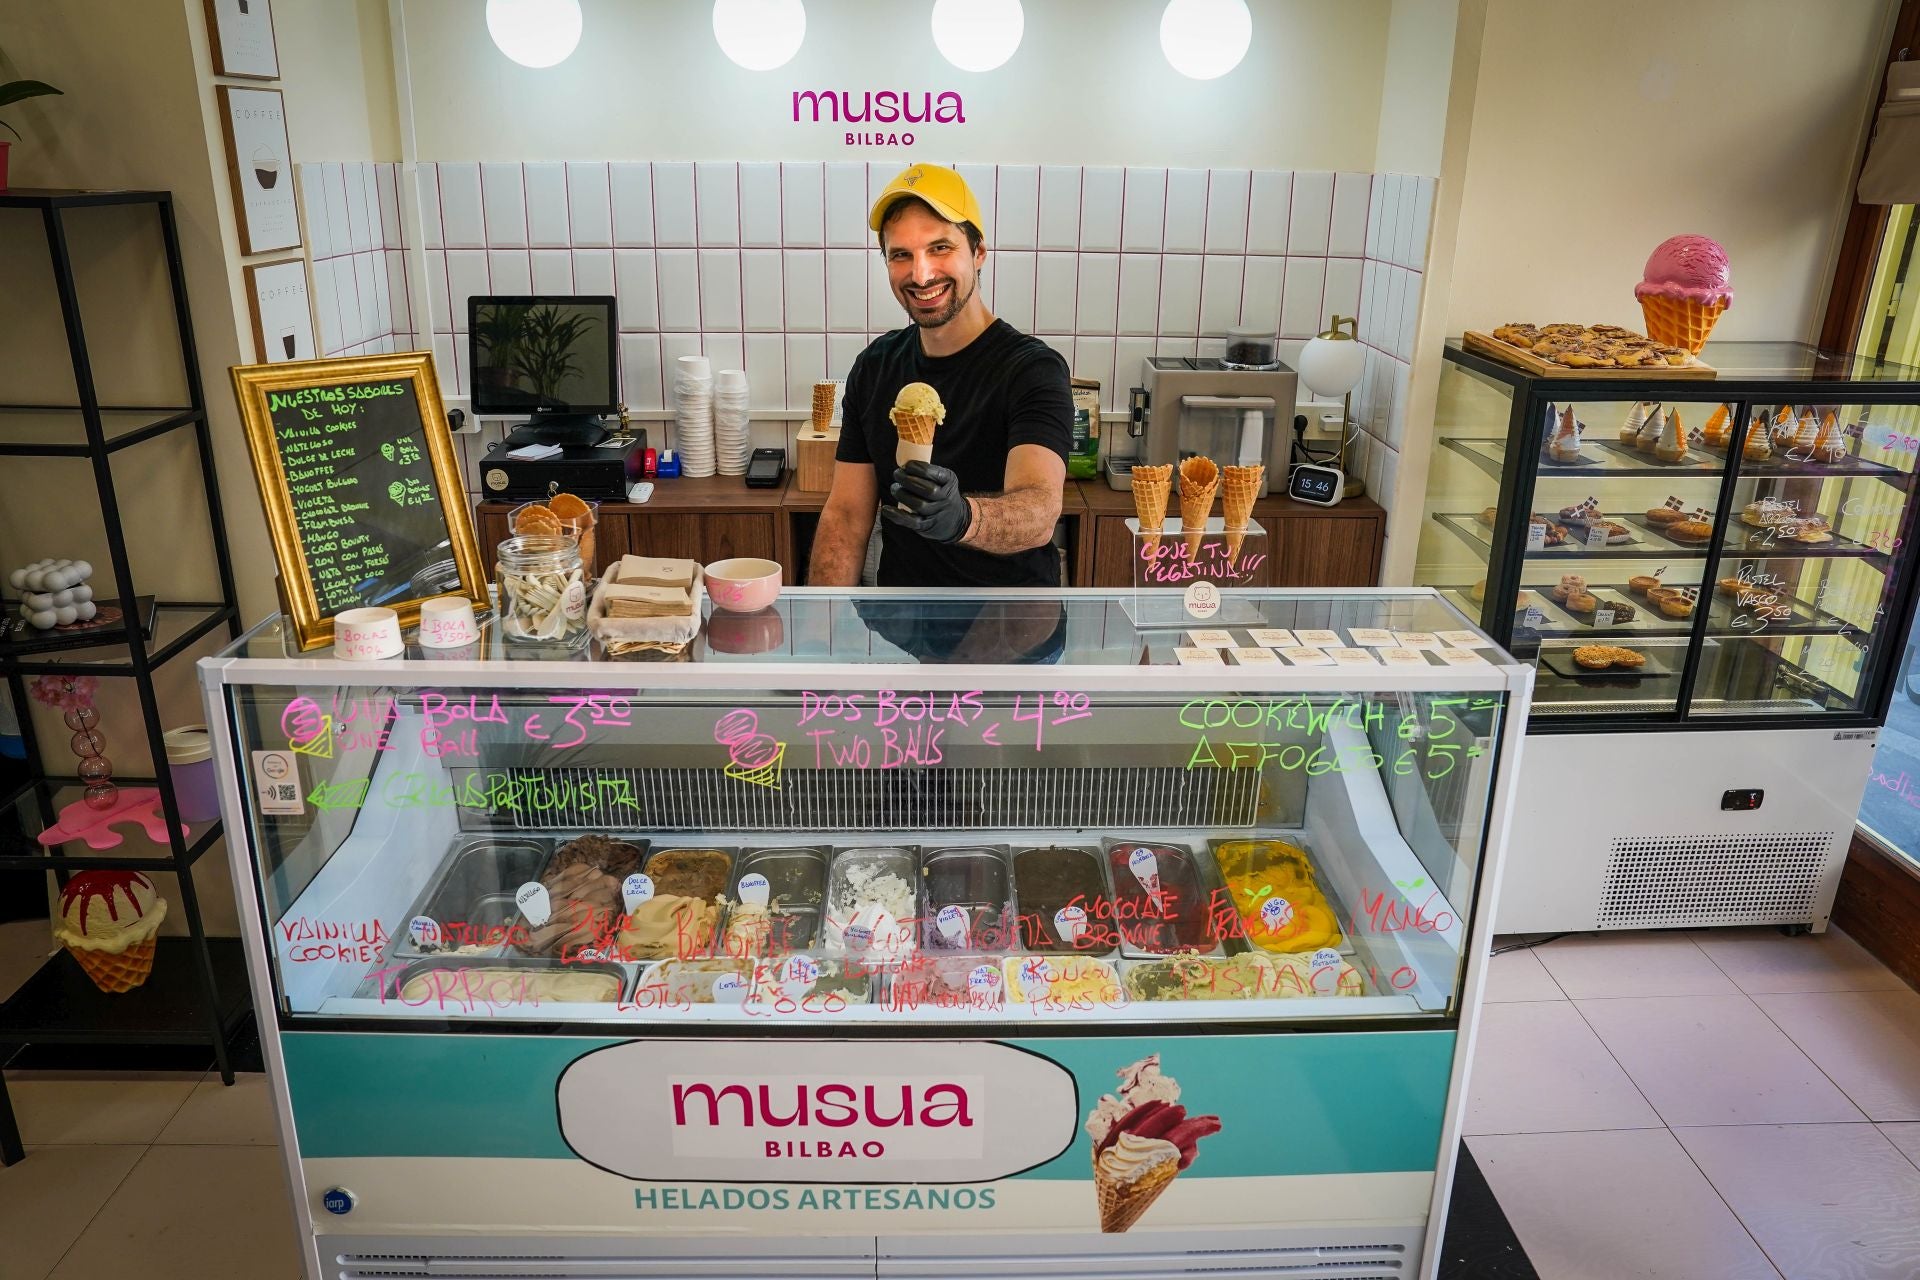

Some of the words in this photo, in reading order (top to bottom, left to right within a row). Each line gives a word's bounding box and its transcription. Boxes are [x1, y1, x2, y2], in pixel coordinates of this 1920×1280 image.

[236, 109, 281, 120] COFFEE
[793, 90, 966, 123] musua
[845, 133, 915, 146] BILBAO
[271, 388, 345, 412] NUESTROS
[347, 384, 404, 399] SABORES
[301, 408, 323, 420] DE
[331, 448, 356, 459] LECHE
[1301, 478, 1312, 489] 15
[1316, 481, 1329, 492] 46
[341, 551, 359, 561] CON
[1202, 542, 1231, 558] TU
[419, 693, 509, 727] BOLA
[796, 690, 864, 728] DOS
[874, 688, 984, 729] BOLAS
[337, 730, 398, 752] ONE
[806, 729, 872, 769] TWO
[1349, 887, 1453, 935] MANGO
[289, 943, 385, 963] COOKIES
[617, 982, 693, 1013] LOTUS
[672, 1083, 974, 1127] musua
[765, 1140, 885, 1158] BILBAO
[326, 1198, 344, 1211] iarp
[634, 1187, 791, 1209] HELADOS
[797, 1187, 996, 1209] ARTESANOS
